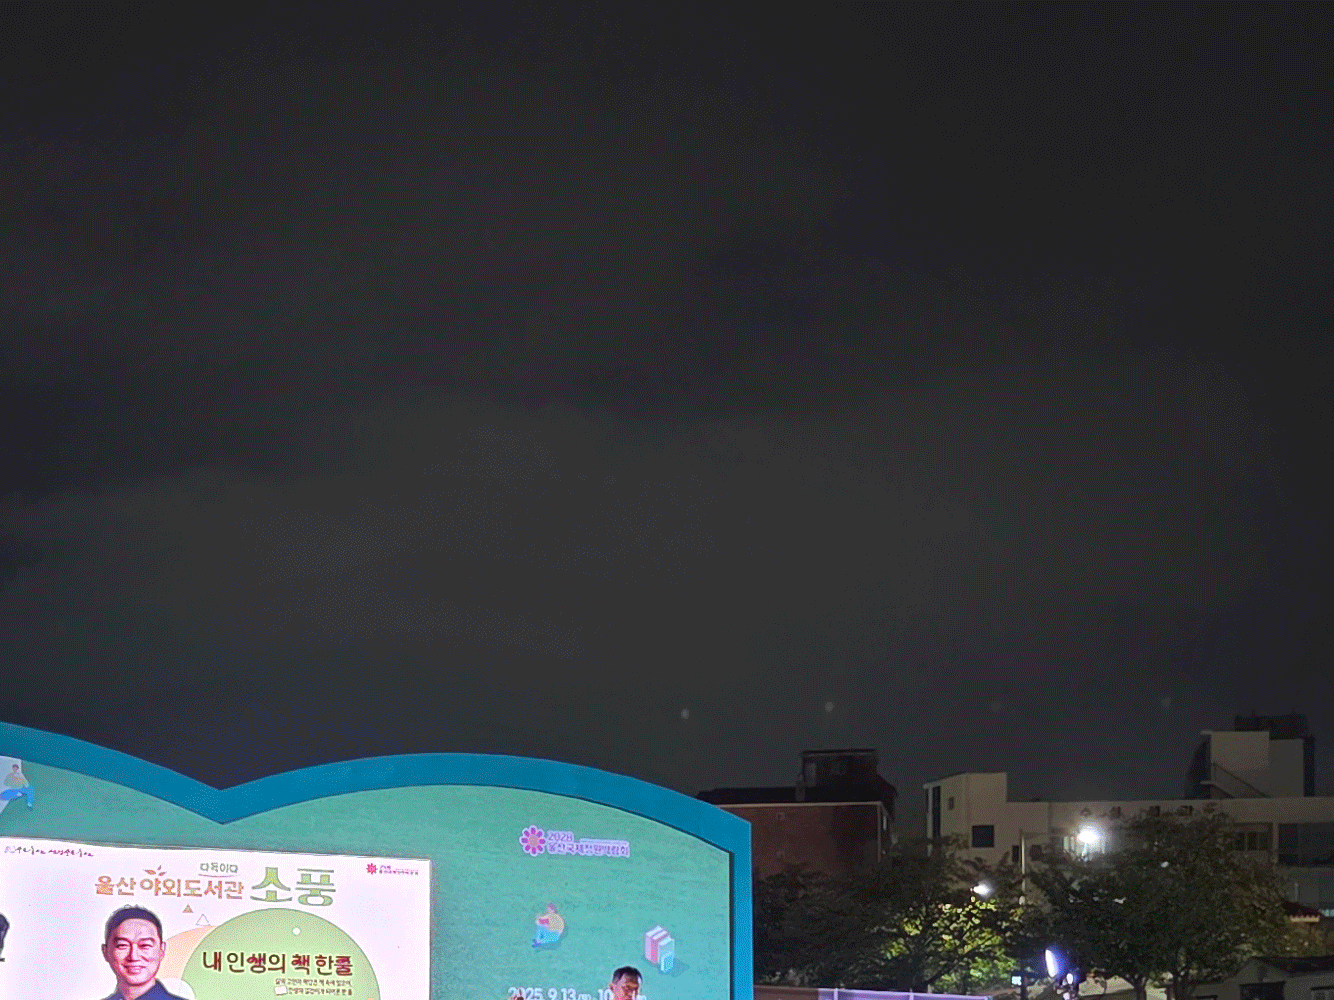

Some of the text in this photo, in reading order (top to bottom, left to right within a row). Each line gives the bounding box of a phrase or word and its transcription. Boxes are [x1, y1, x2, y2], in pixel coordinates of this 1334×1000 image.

[250, 866, 336, 907] 소풍
[203, 951, 222, 973] 내
[291, 953, 311, 976] 책
